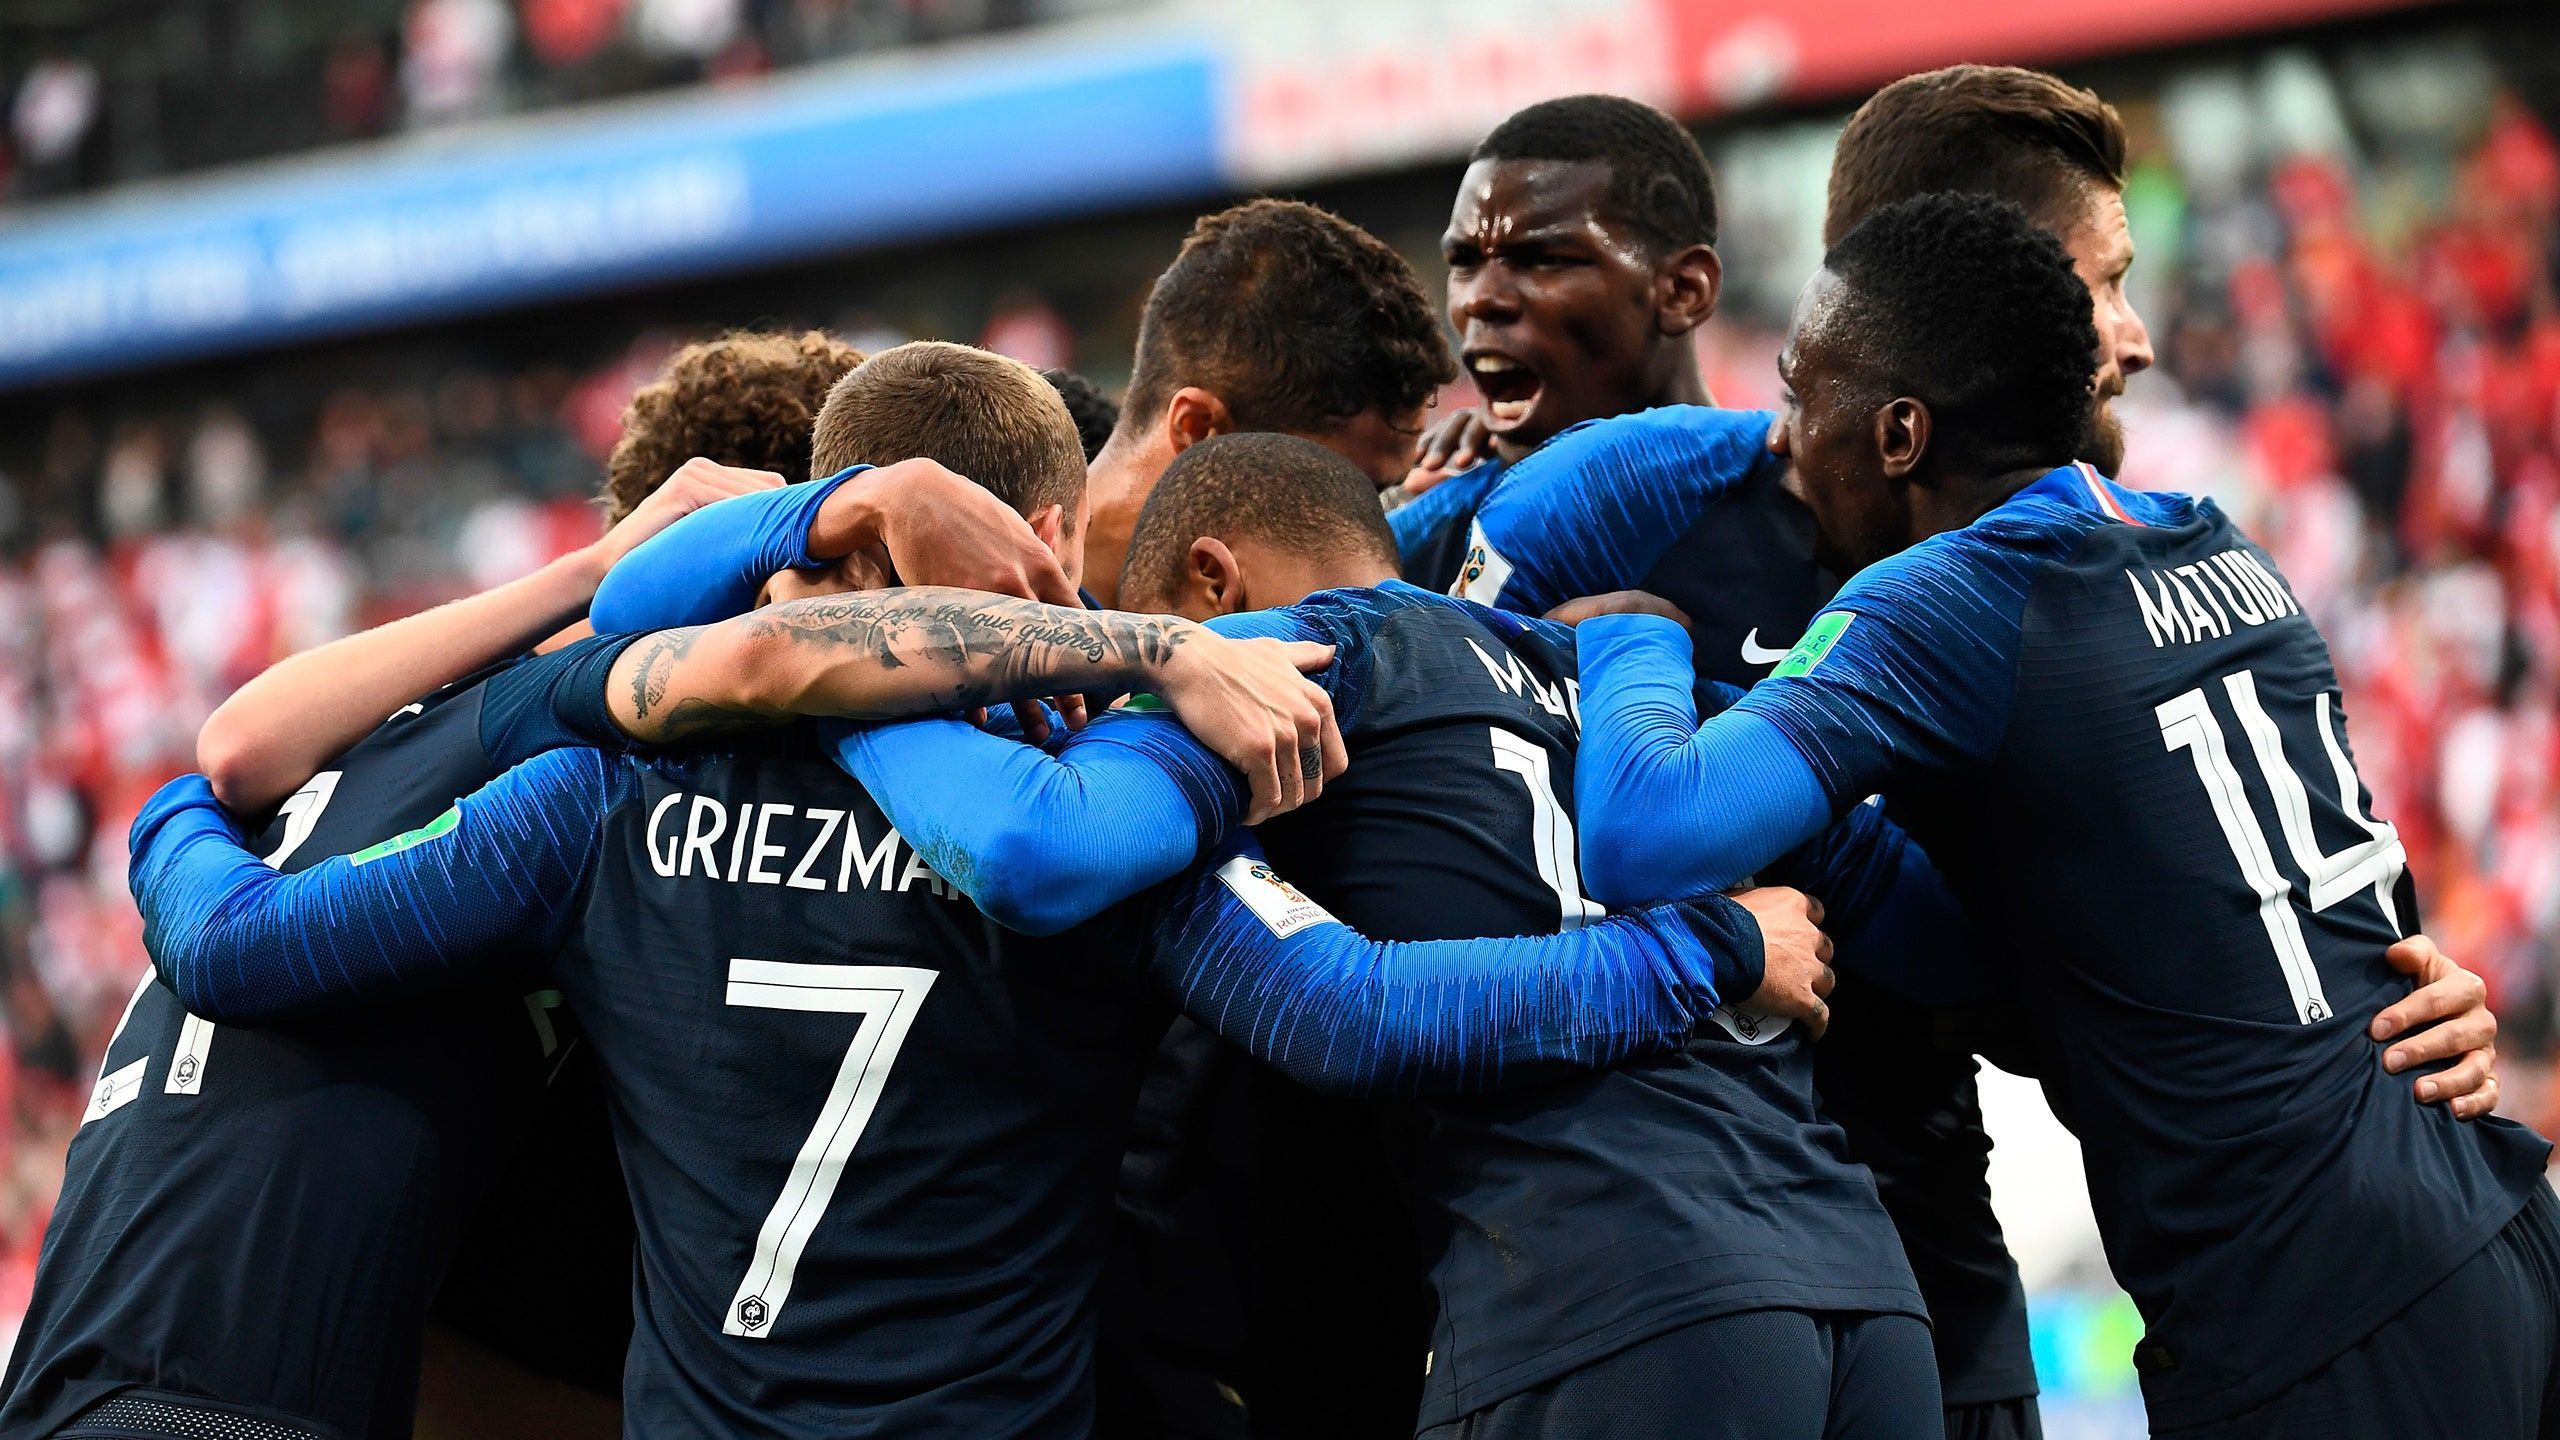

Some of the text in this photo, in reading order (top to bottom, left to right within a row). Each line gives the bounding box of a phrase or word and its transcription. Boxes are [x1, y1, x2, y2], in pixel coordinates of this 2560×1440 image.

[646, 792, 959, 901] GRIEZMA
[2154, 669, 2407, 1026] 14
[722, 958, 940, 1339] 7
